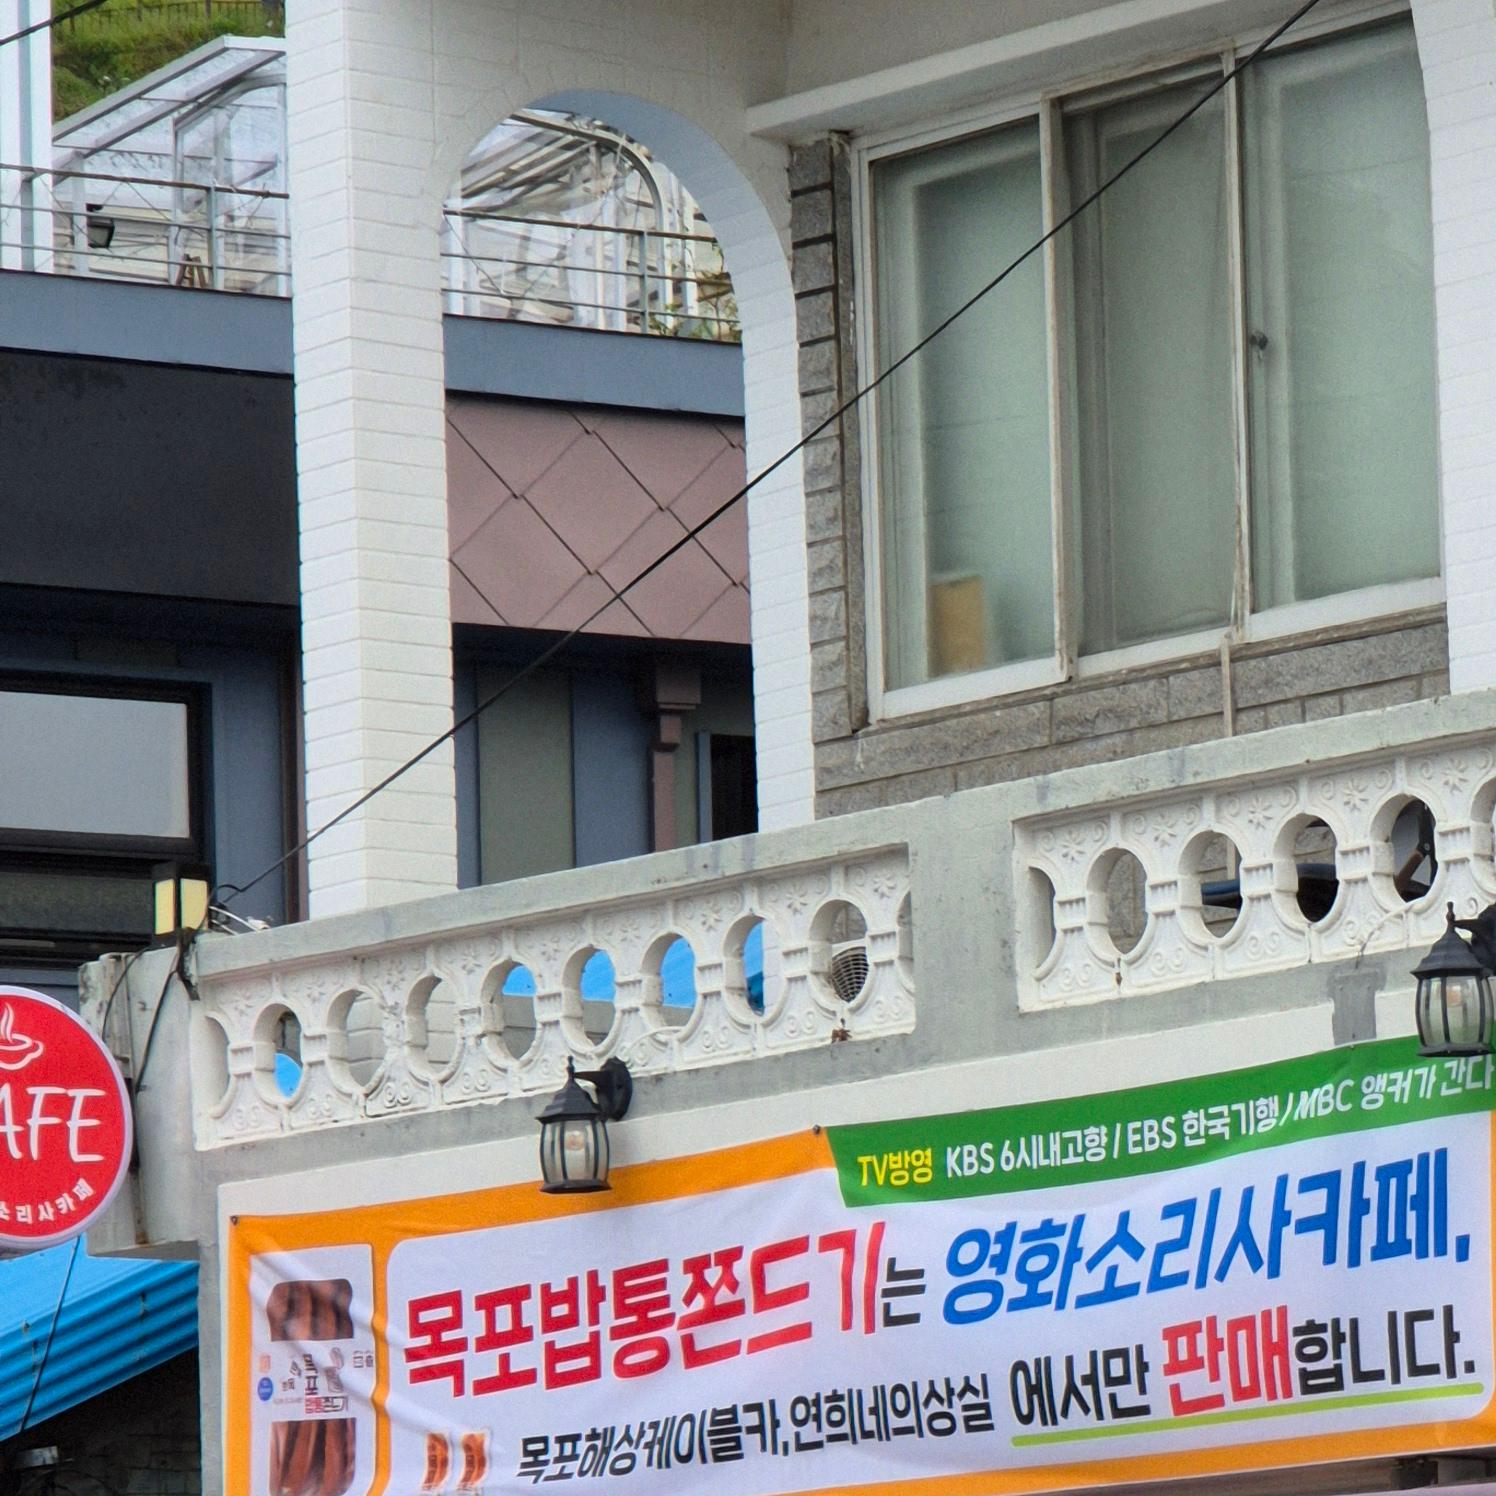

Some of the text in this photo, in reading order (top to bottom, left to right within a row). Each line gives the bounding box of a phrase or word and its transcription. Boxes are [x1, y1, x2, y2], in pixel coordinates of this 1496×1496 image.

[0, 1083, 106, 1163] AFE
[857, 1147, 933, 1188] TV방영
[946, 1142, 994, 1178] KBS
[1000, 1126, 1107, 1173] 6시내고향
[1128, 1116, 1176, 1155] EBS
[1361, 1067, 1437, 1110] 앵커가
[1440, 1054, 1495, 1097] 간다
[405, 1220, 926, 1398] 목포밥통쫀드기는
[1009, 1344, 1151, 1429] 에서만
[1161, 1304, 1477, 1418] 판매합니다.
